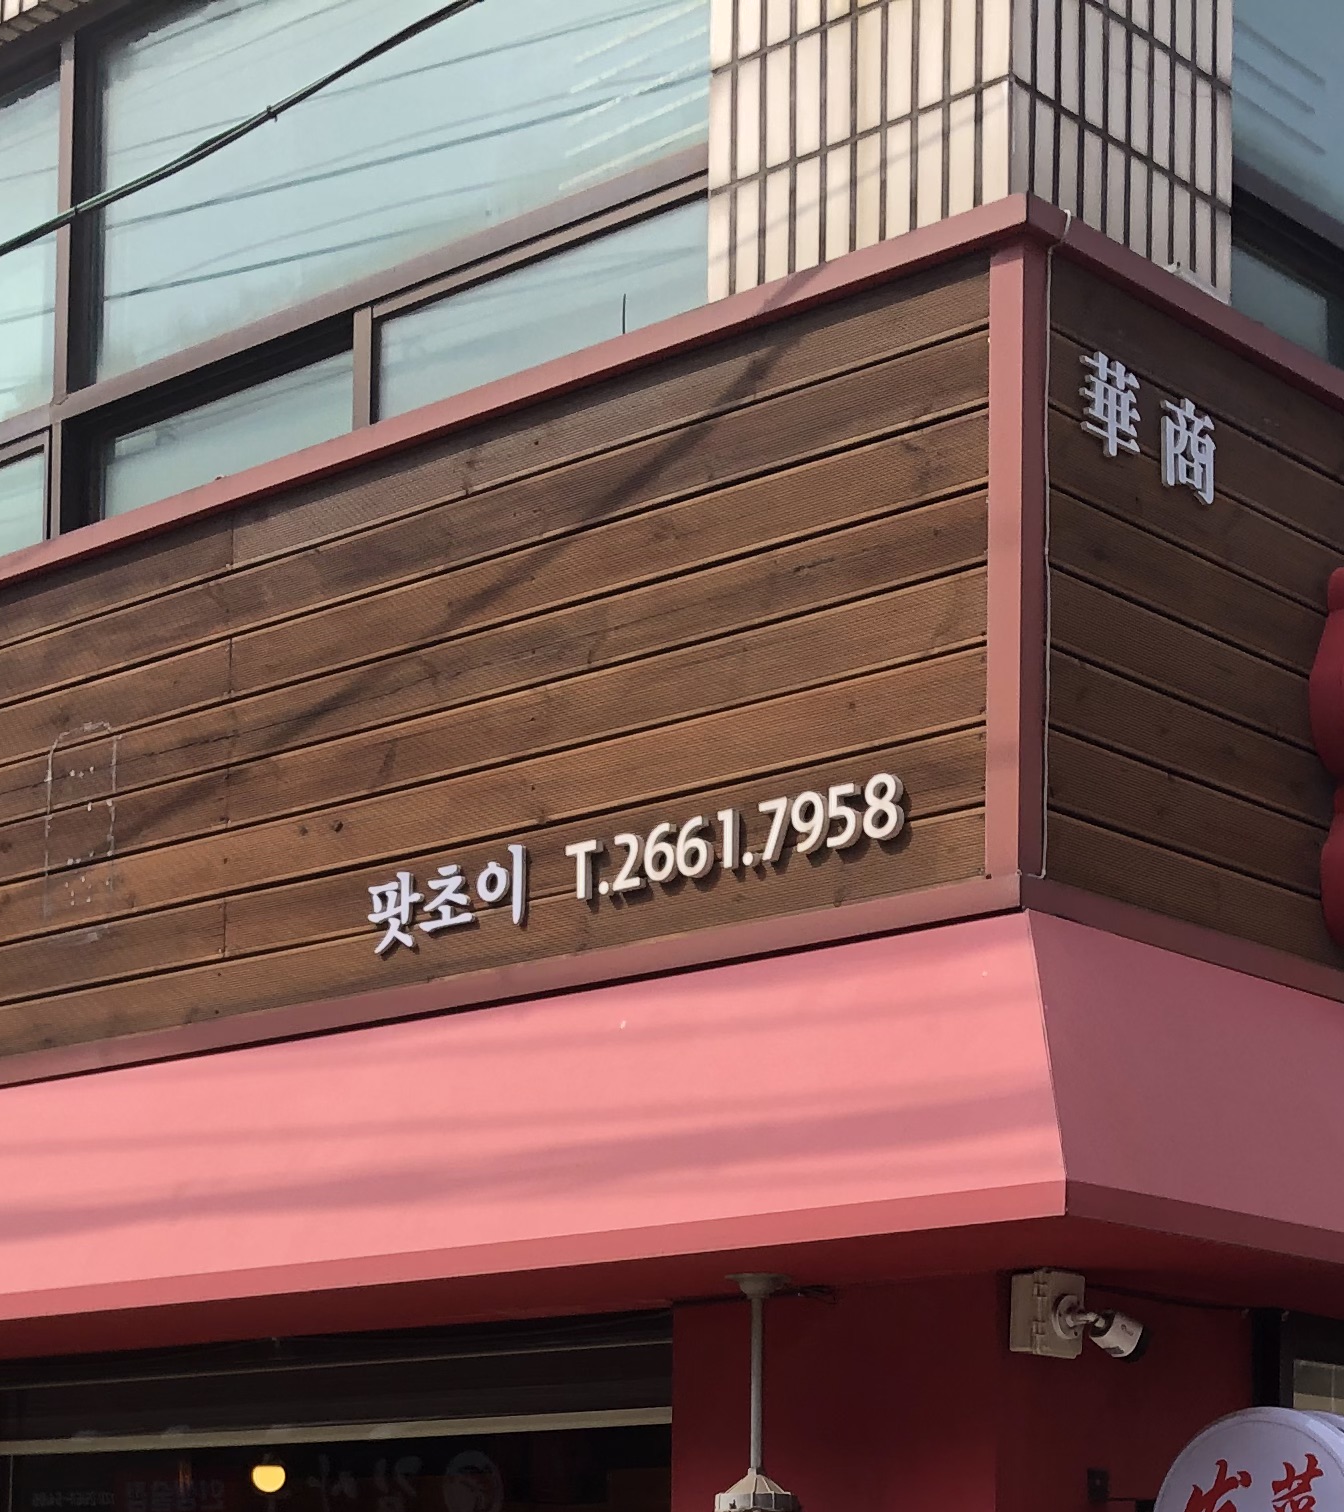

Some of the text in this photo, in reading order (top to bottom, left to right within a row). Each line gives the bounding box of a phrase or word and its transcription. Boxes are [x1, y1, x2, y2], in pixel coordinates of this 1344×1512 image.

[1080, 351, 1216, 505] 華商
[368, 773, 907, 955] 팟초이 T.2661.7958
